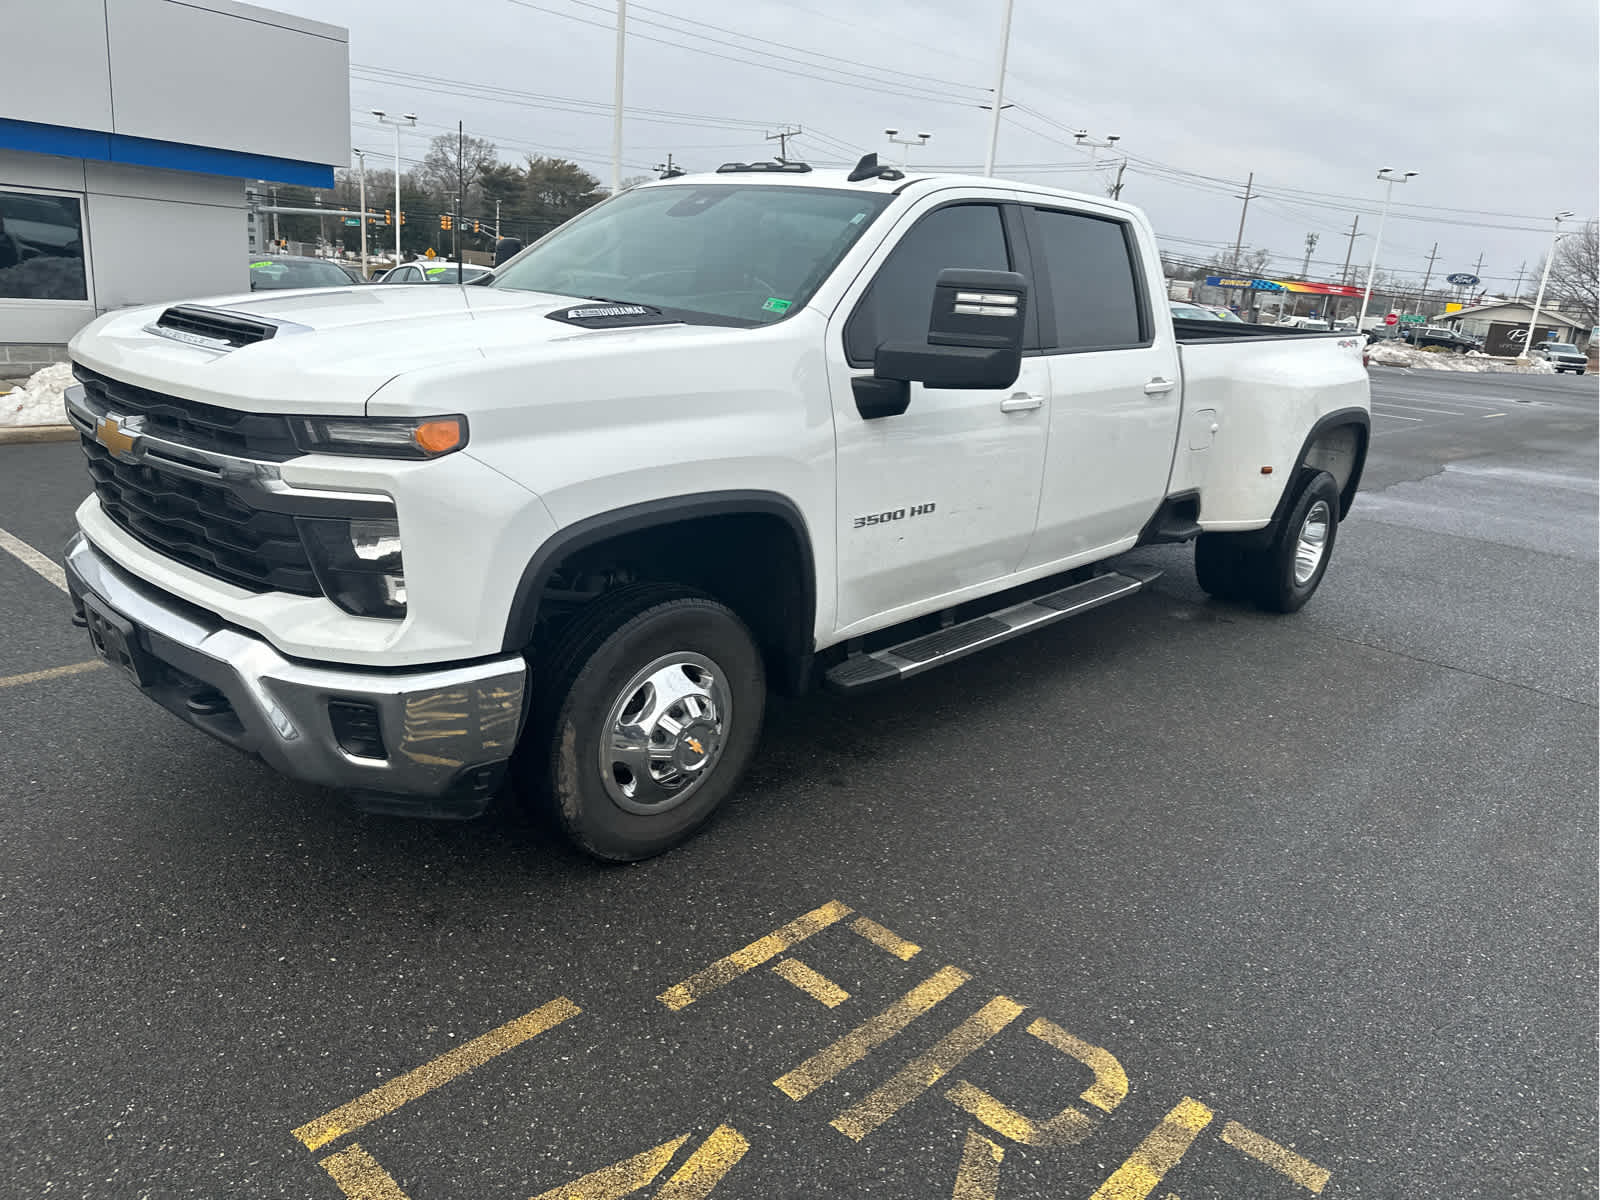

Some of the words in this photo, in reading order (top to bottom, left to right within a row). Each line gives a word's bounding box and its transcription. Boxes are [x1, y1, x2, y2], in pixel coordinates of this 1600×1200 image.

[1218, 278, 1252, 287] SUNOCO
[600, 306, 647, 316] DURAMAX
[853, 509, 905, 528] 3500
[910, 503, 936, 517] HD
